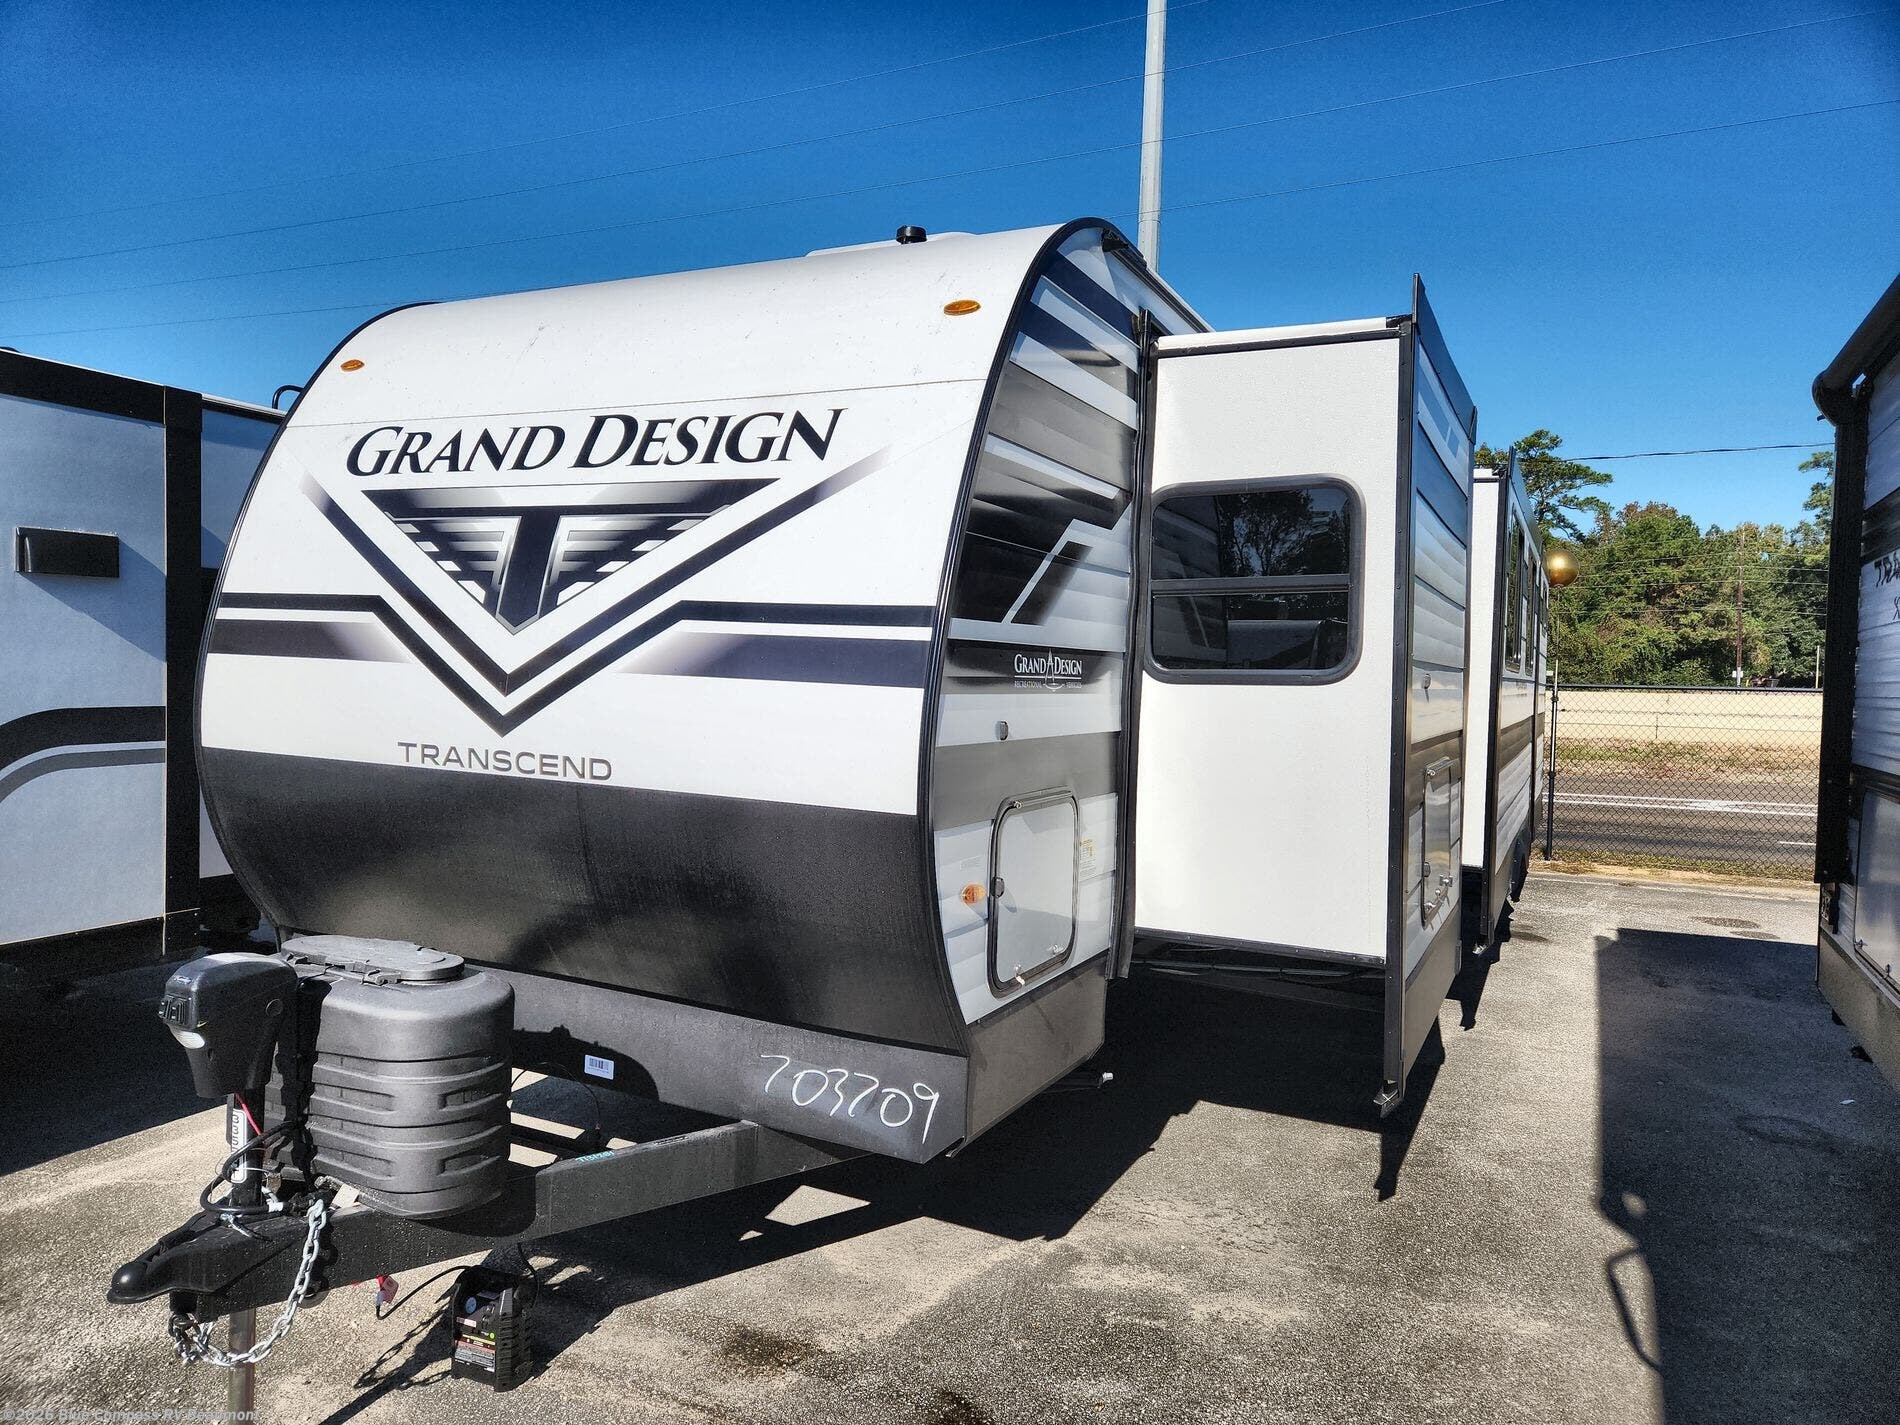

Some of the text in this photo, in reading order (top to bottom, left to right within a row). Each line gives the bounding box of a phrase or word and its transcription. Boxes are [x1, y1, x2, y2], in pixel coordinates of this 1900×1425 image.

[346, 408, 848, 476] GRAND DESIGN
[1014, 653, 1082, 675] GRAND DESIGN
[397, 741, 613, 781] TRANSCEND
[760, 1054, 940, 1145] 703709
